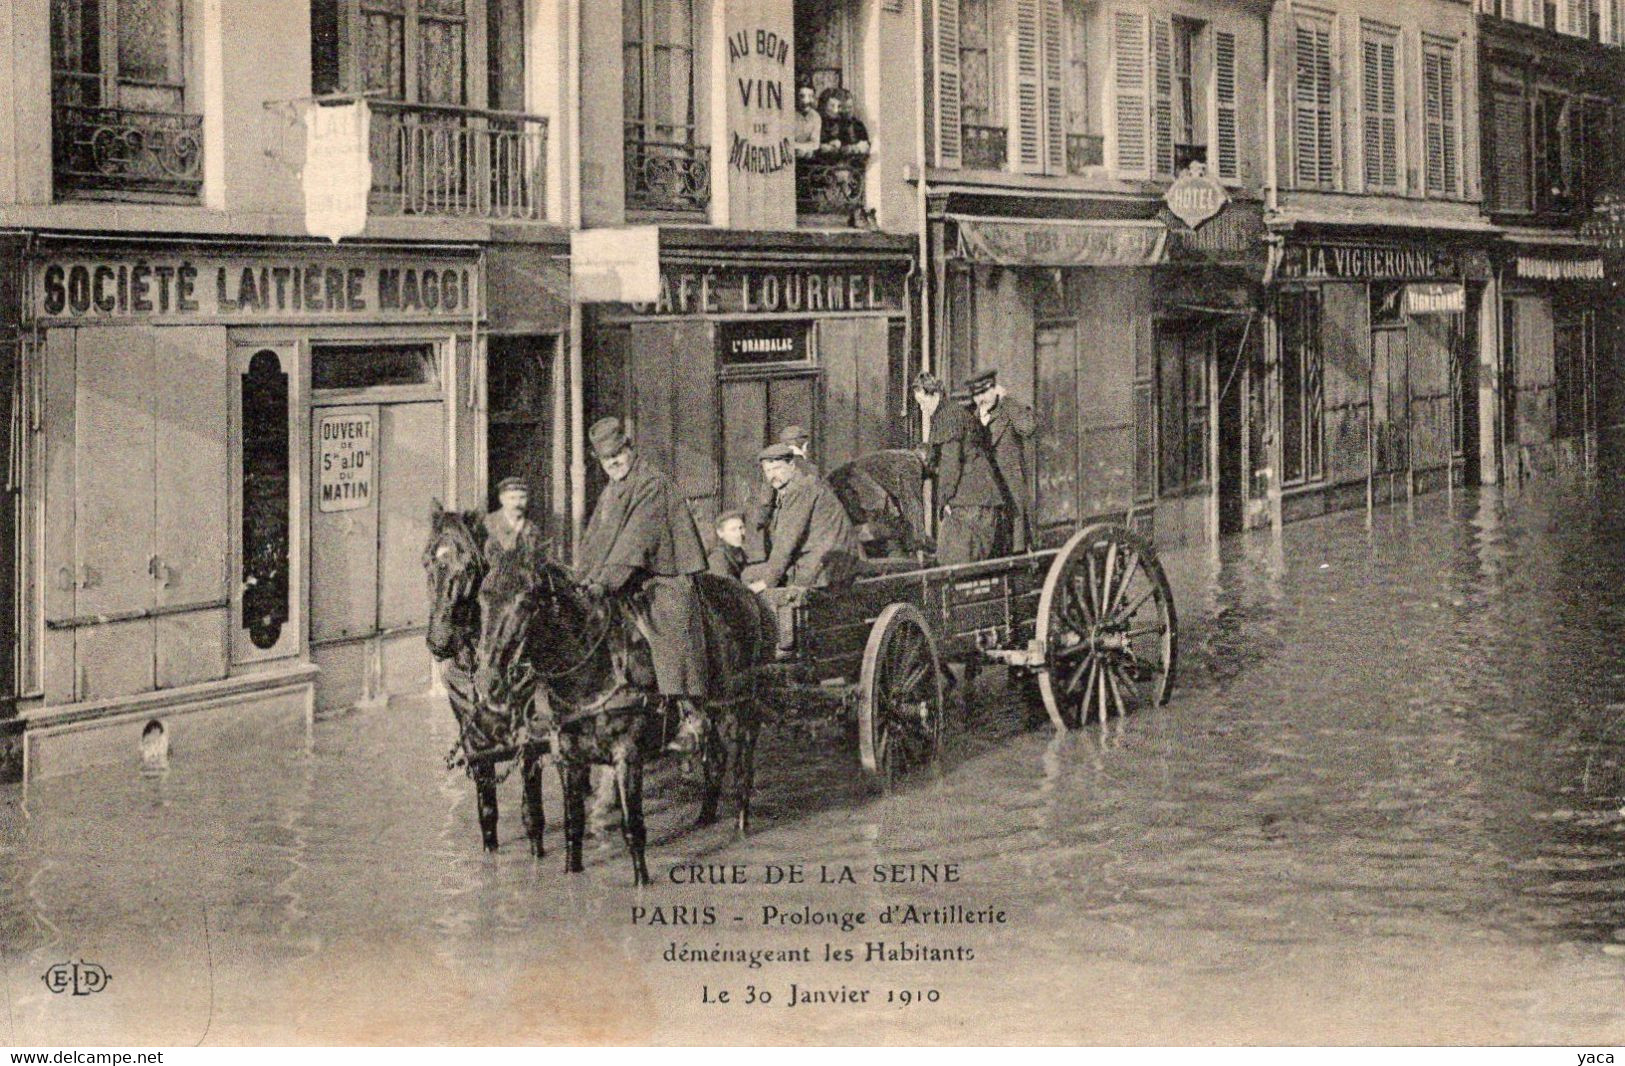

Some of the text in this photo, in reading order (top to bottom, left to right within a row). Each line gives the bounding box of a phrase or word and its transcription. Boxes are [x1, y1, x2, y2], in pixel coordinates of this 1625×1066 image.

[728, 29, 789, 65] AU BON
[738, 77, 782, 110] VIN
[1305, 248, 1328, 278] LA
[1334, 248, 1436, 279] VIGNERONNE
[44, 260, 470, 316] SOCIÉTÉ LAITIÈRE MAGGI
[632, 268, 883, 313] AFÉ LOURMEL
[323, 421, 371, 440] OUVERT
[322, 481, 369, 501] MATIN
